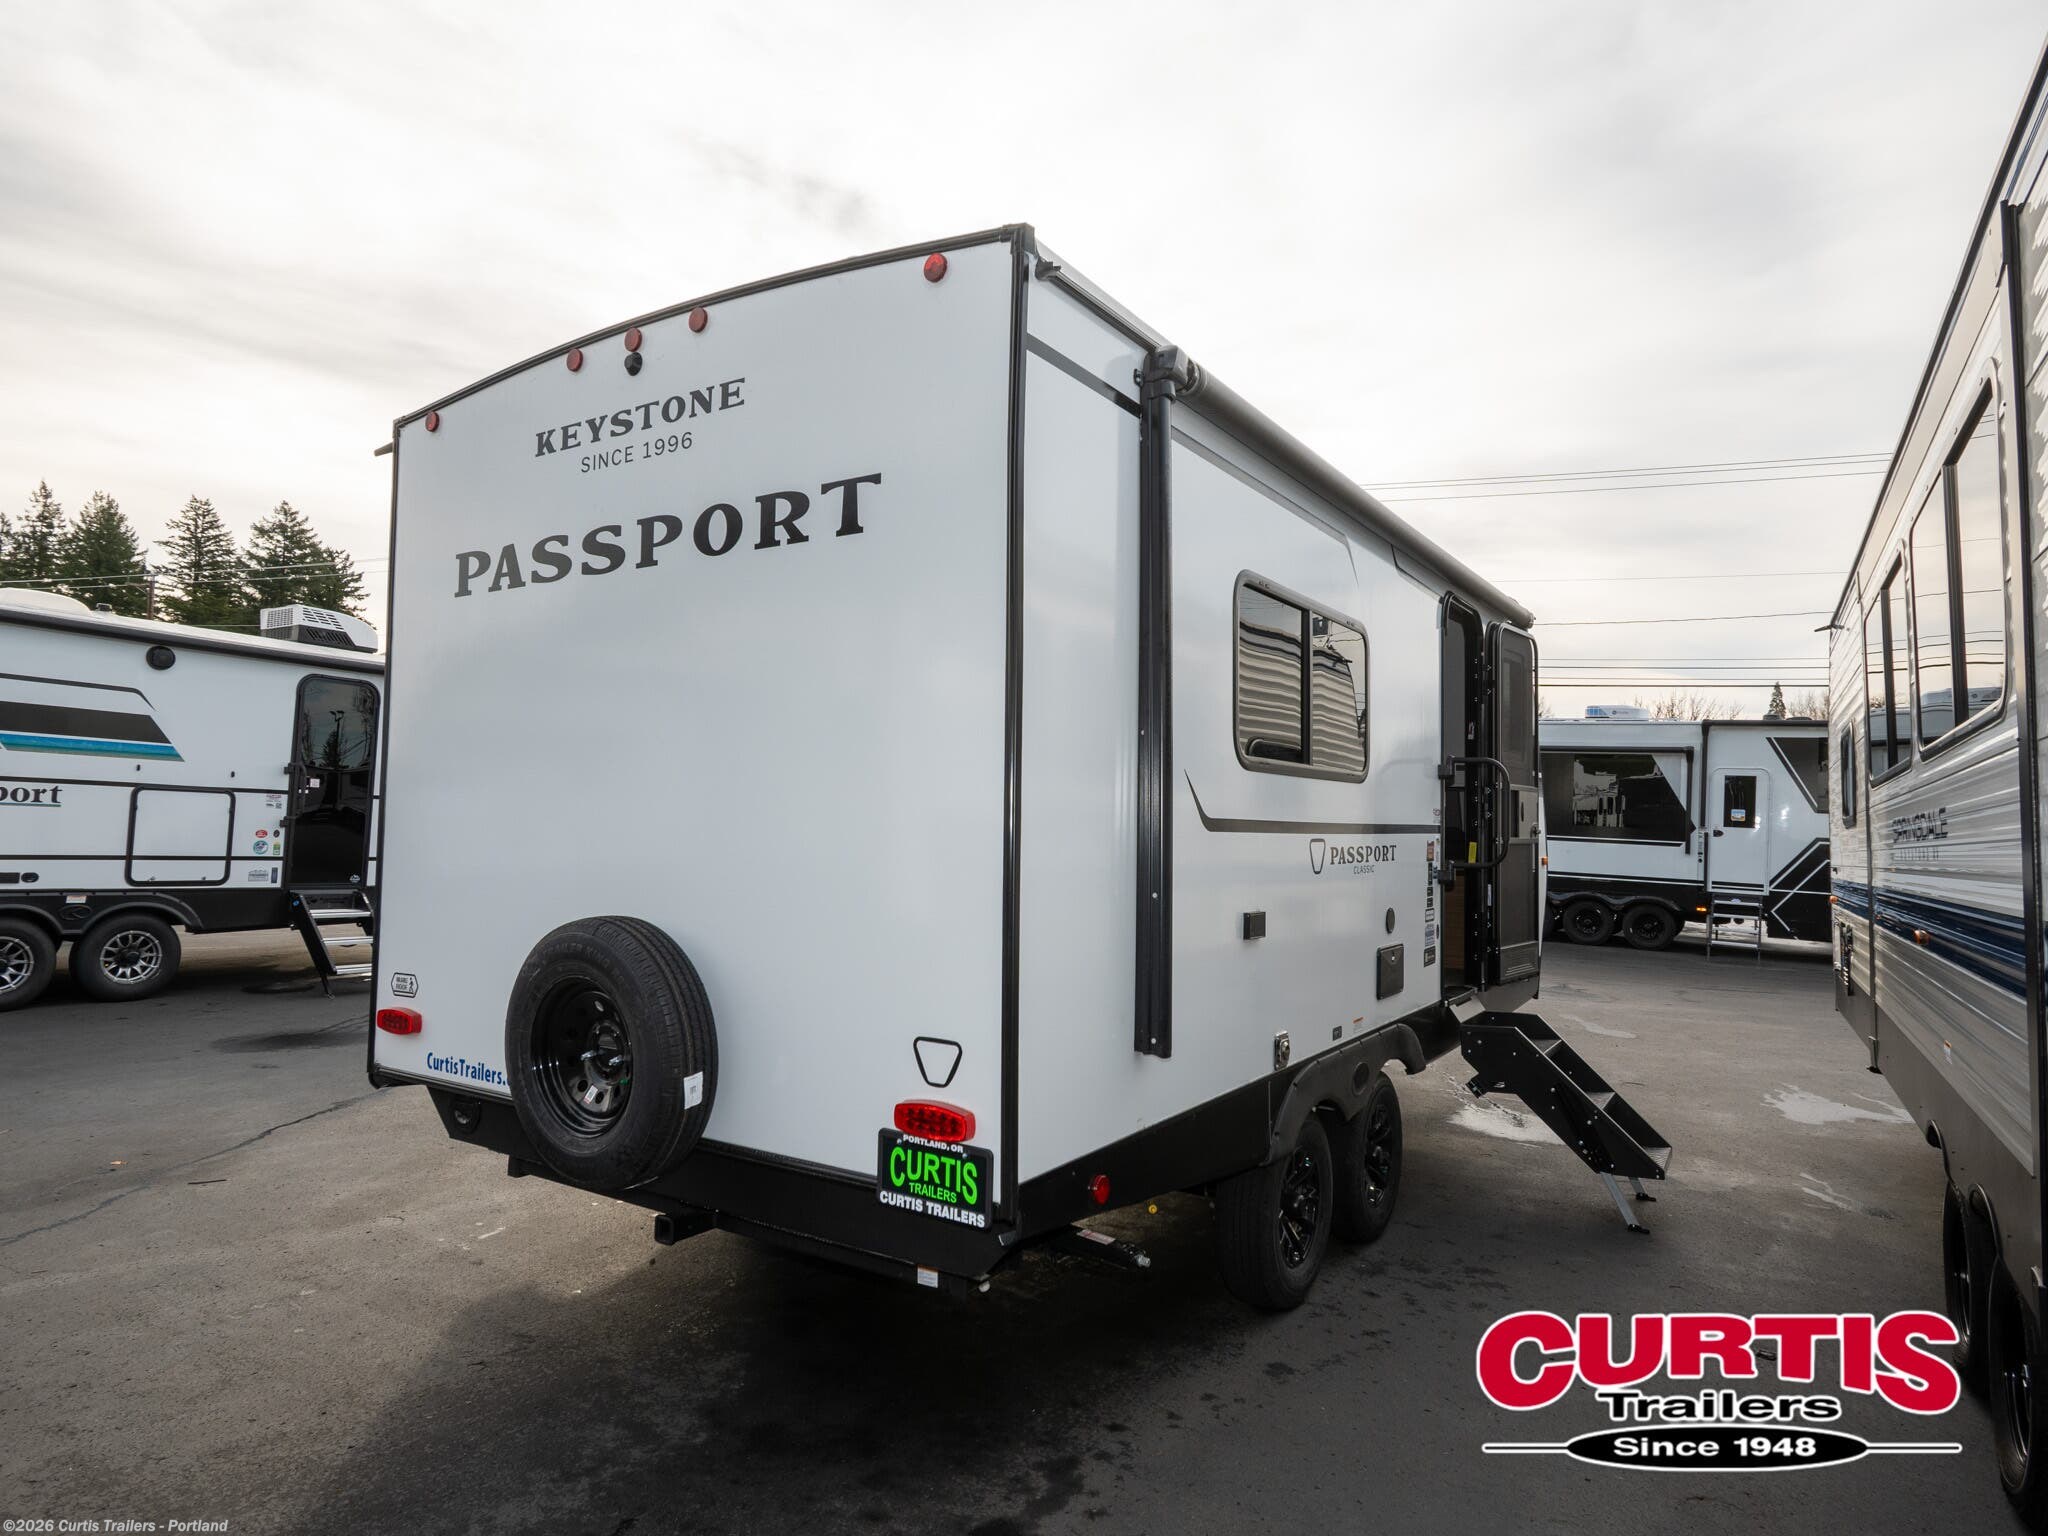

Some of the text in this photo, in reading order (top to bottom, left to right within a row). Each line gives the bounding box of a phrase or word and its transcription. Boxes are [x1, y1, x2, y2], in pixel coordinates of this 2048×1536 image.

[534, 376, 745, 458] KEYSTONE
[580, 431, 693, 473] SINCE 1996
[454, 472, 882, 598] PASSPORT
[1330, 844, 1396, 865] PASSPORT
[1353, 865, 1375, 874] CLASSIC
[903, 1134, 963, 1153] PORTLAND, OR
[890, 1146, 977, 1205] CURTIS
[909, 1182, 957, 1204] TRAILERS
[880, 1190, 985, 1229] CURTIS TRAILERS
